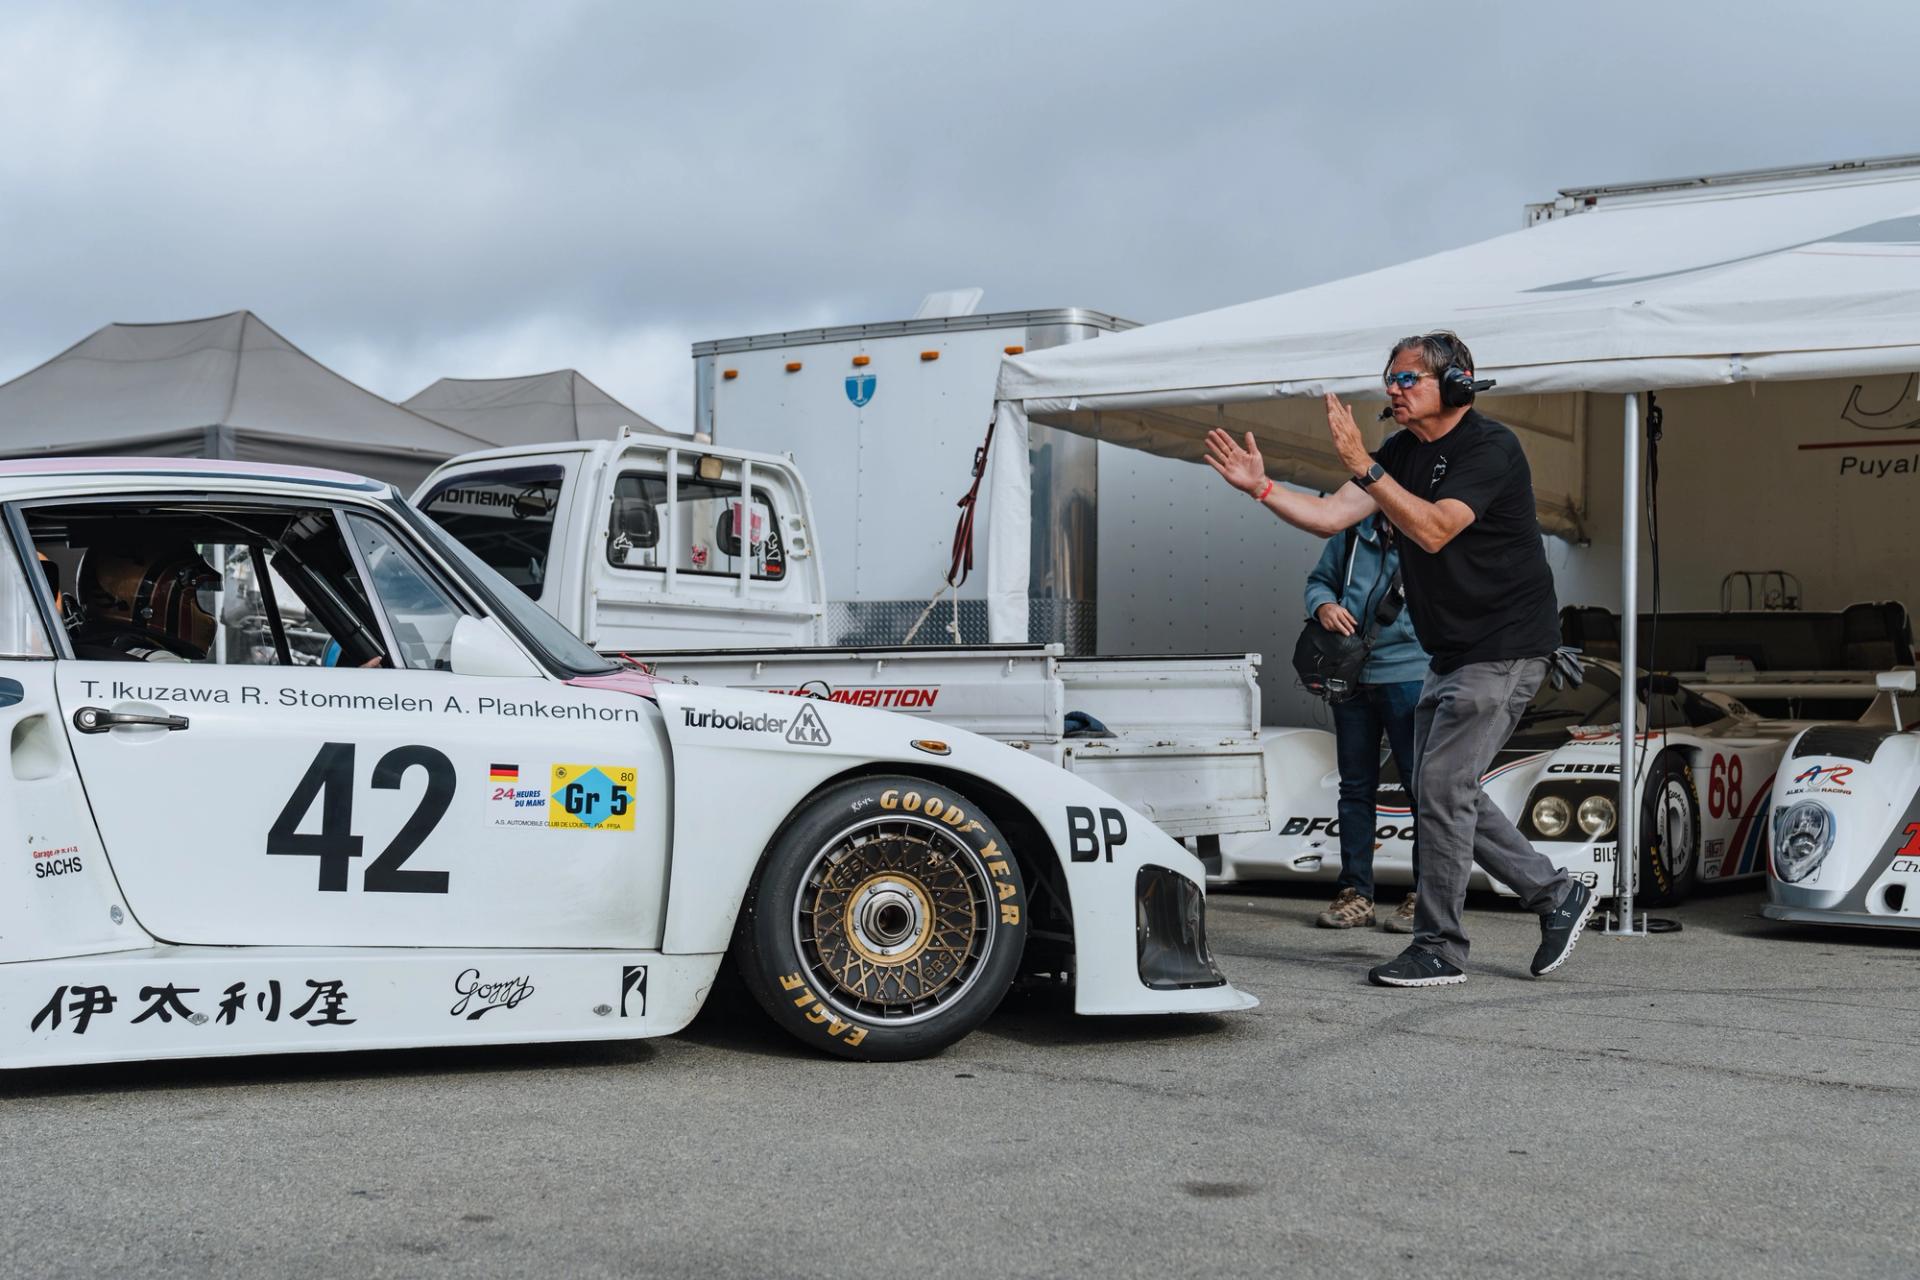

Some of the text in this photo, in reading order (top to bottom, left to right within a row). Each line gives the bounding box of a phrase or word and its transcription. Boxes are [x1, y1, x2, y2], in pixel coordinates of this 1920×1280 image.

[80, 680, 640, 722] T. Ikuzawa R. Stommelen A. Plankenhorn
[829, 689, 939, 707] AMBITION
[680, 706, 788, 734] Turbolader
[620, 772, 634, 782] 80
[1708, 752, 1743, 819] 68
[492, 787, 515, 801] 24
[516, 789, 541, 799] HEURES
[525, 798, 546, 807] MANS
[565, 783, 627, 816] Gr 5
[266, 741, 457, 893] 42
[1066, 805, 1128, 863] BP
[35, 856, 83, 879] SACHS
[924, 951, 951, 979] BBS
